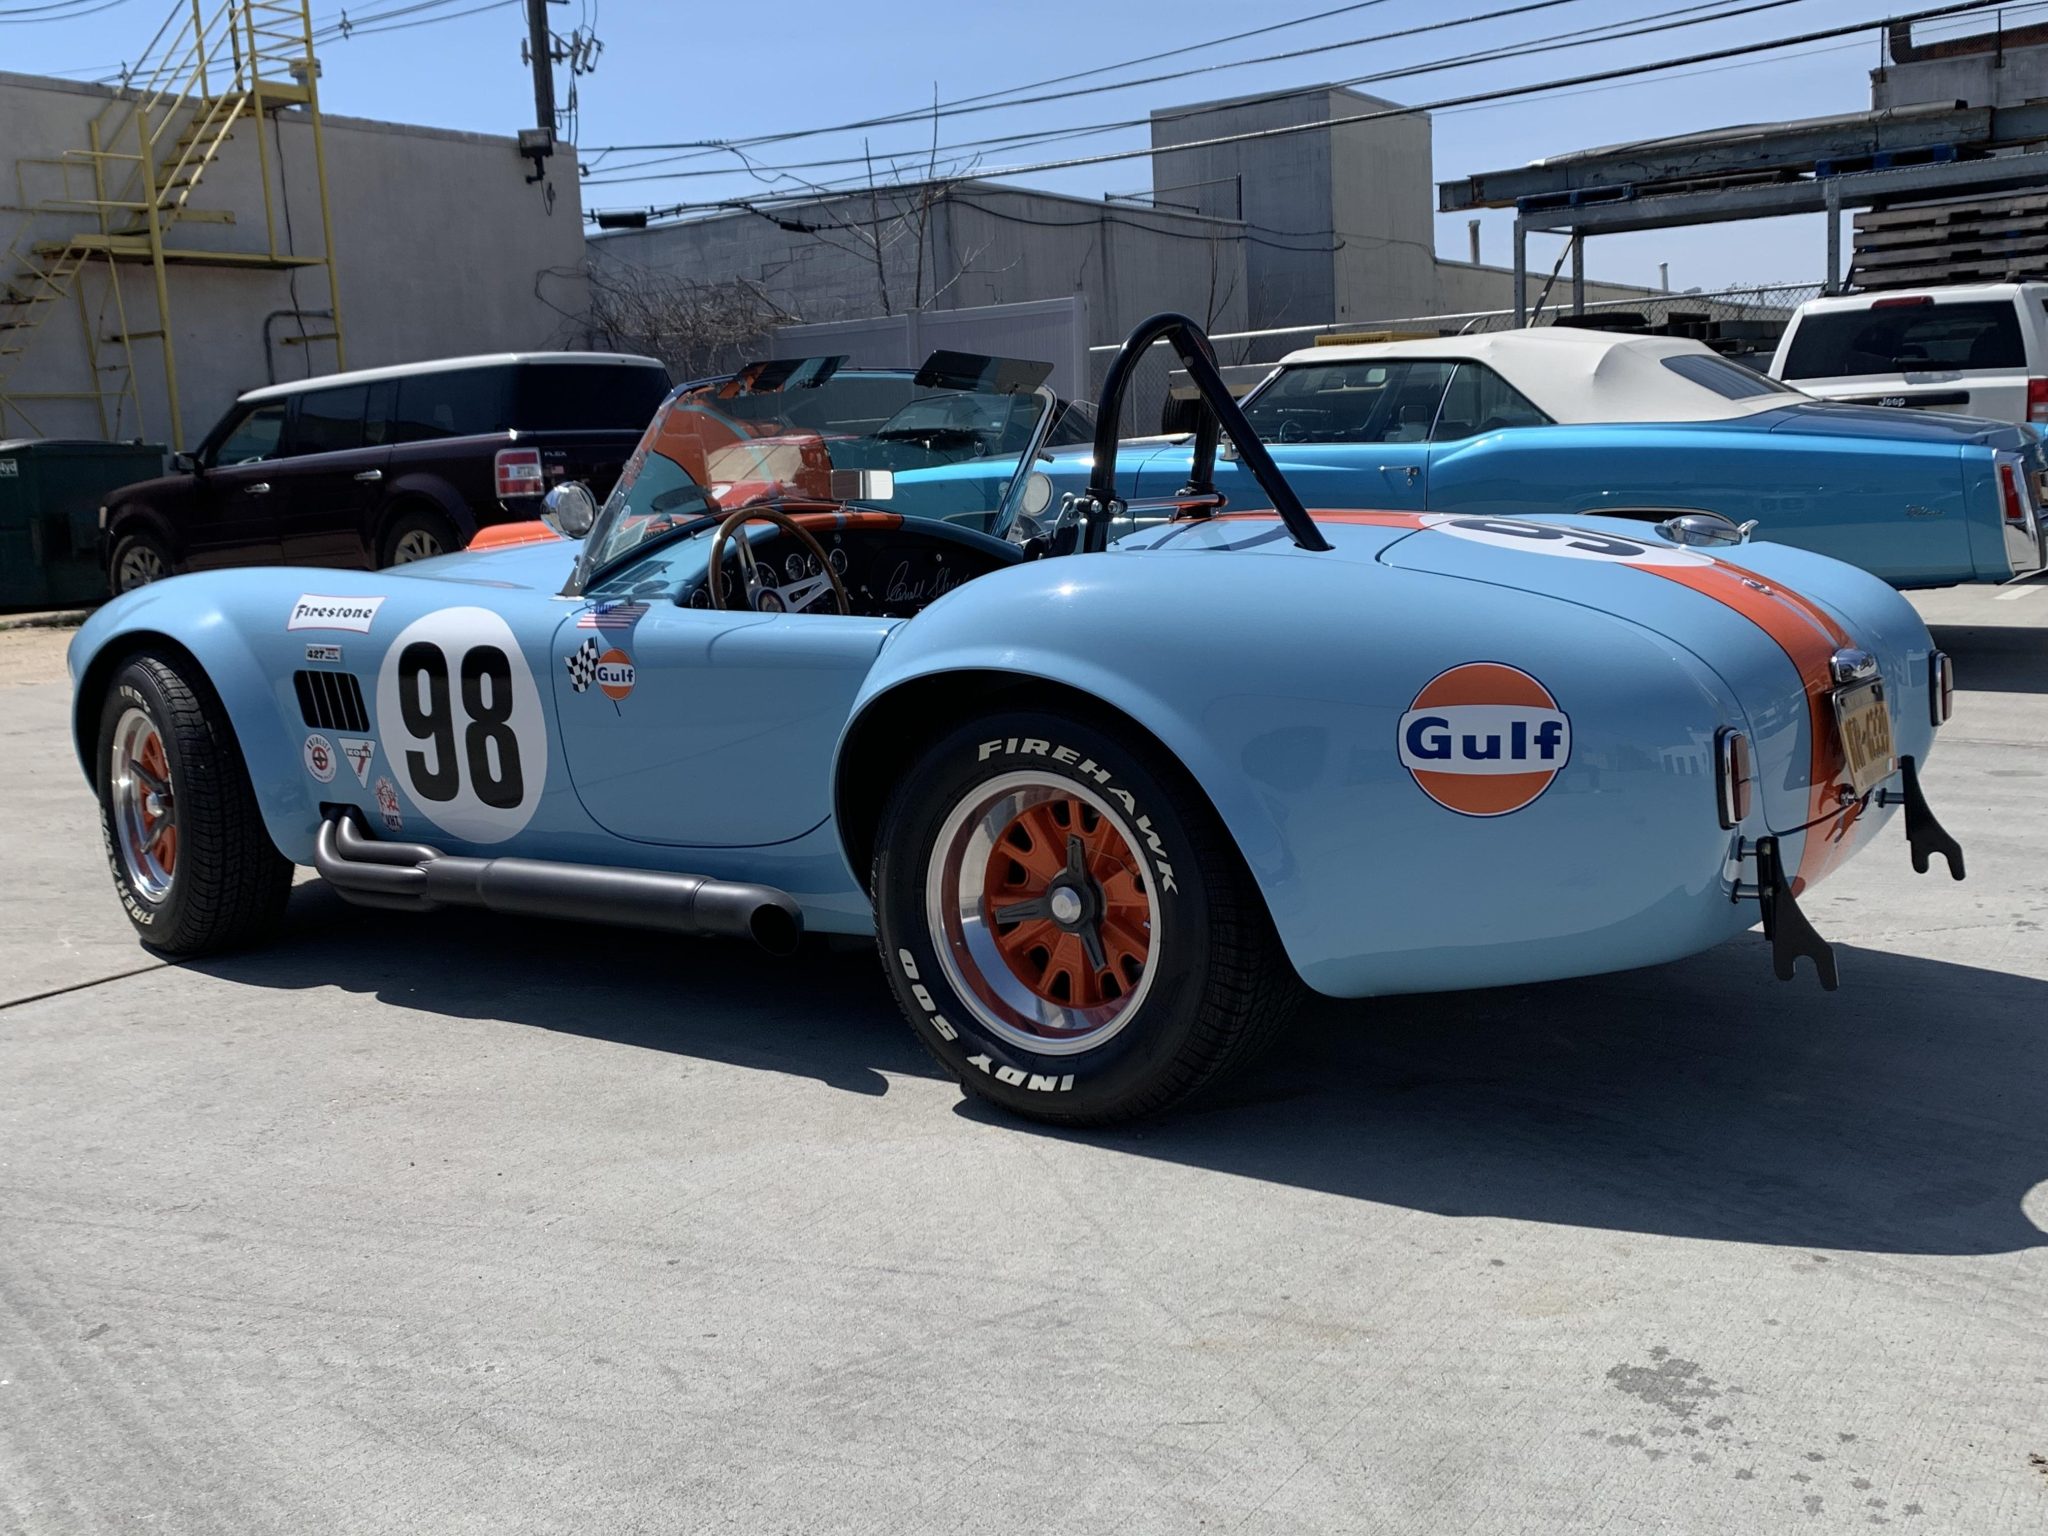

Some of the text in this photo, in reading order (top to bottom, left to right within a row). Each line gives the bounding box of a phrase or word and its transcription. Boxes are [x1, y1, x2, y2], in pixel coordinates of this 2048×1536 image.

[1878, 396, 1906, 408] Jeep
[295, 604, 373, 619] Firestone
[307, 649, 326, 660] 427
[597, 666, 634, 683] Gulf
[398, 640, 524, 809] 98
[1405, 716, 1563, 761] Gulf
[978, 737, 1179, 896] FIREHAWK
[898, 947, 1076, 1093] INDY 500
